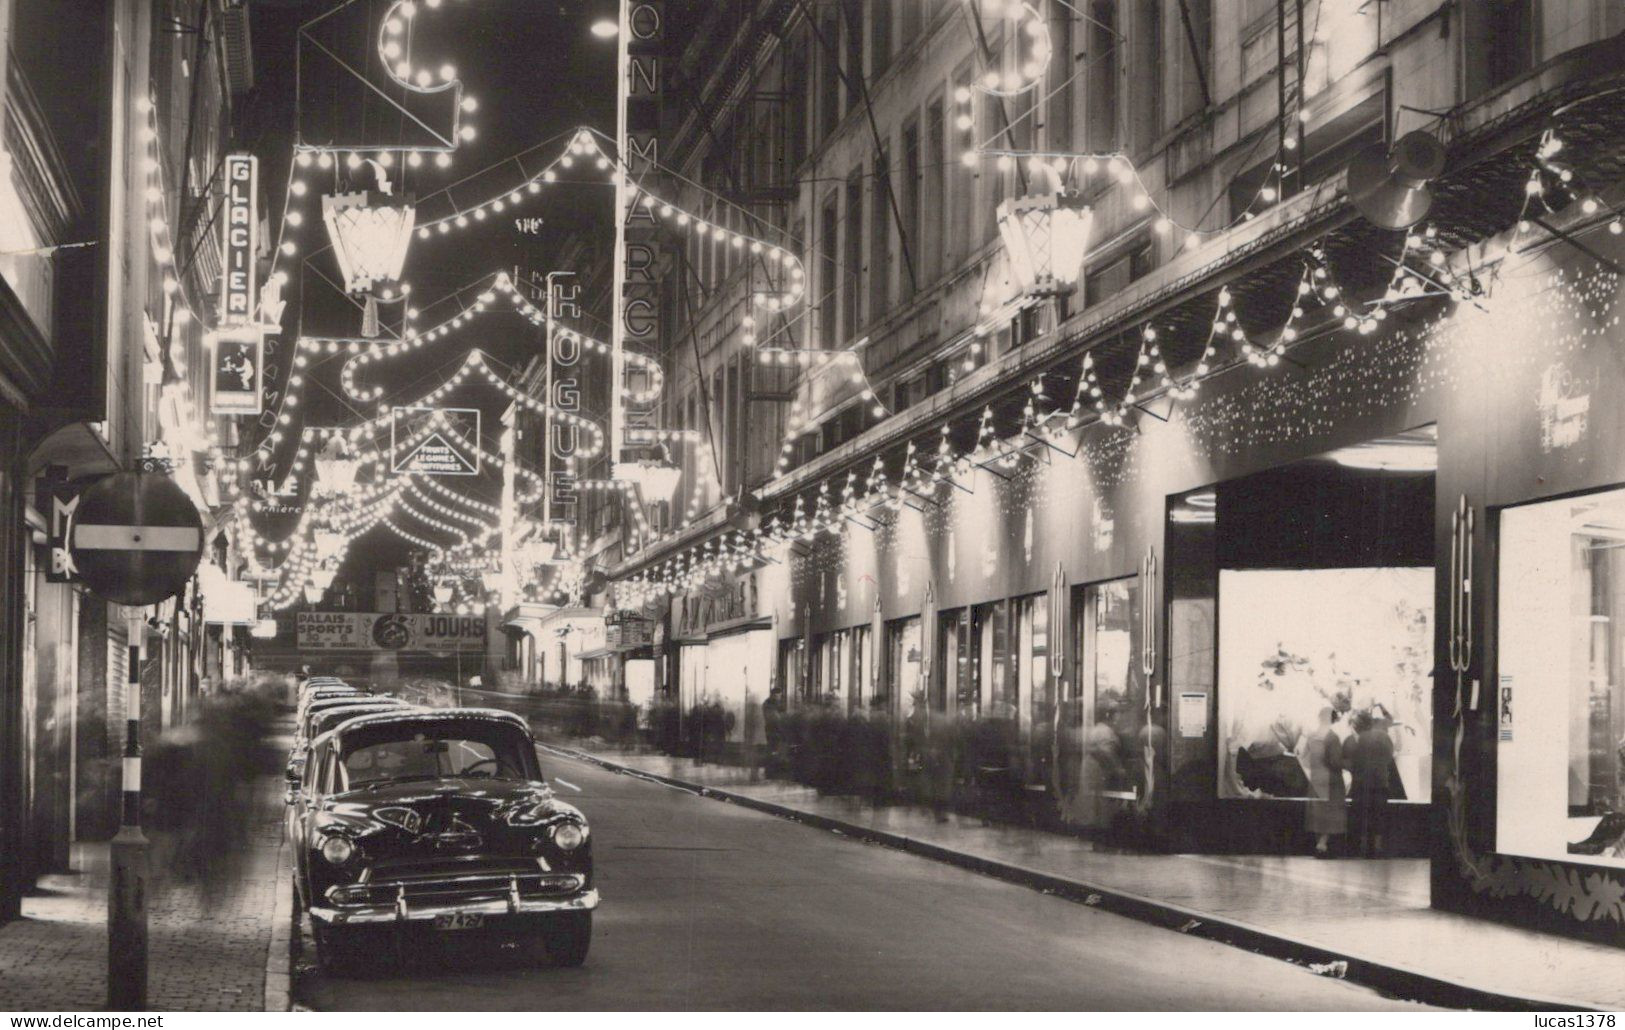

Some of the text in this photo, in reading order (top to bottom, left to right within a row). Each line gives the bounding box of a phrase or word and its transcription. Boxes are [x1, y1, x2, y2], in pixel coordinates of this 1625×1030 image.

[229, 162, 250, 311] GLACIER
[299, 614, 345, 624] PALAIS
[424, 616, 484, 638] JOURS
[299, 624, 353, 634] SPORTS
